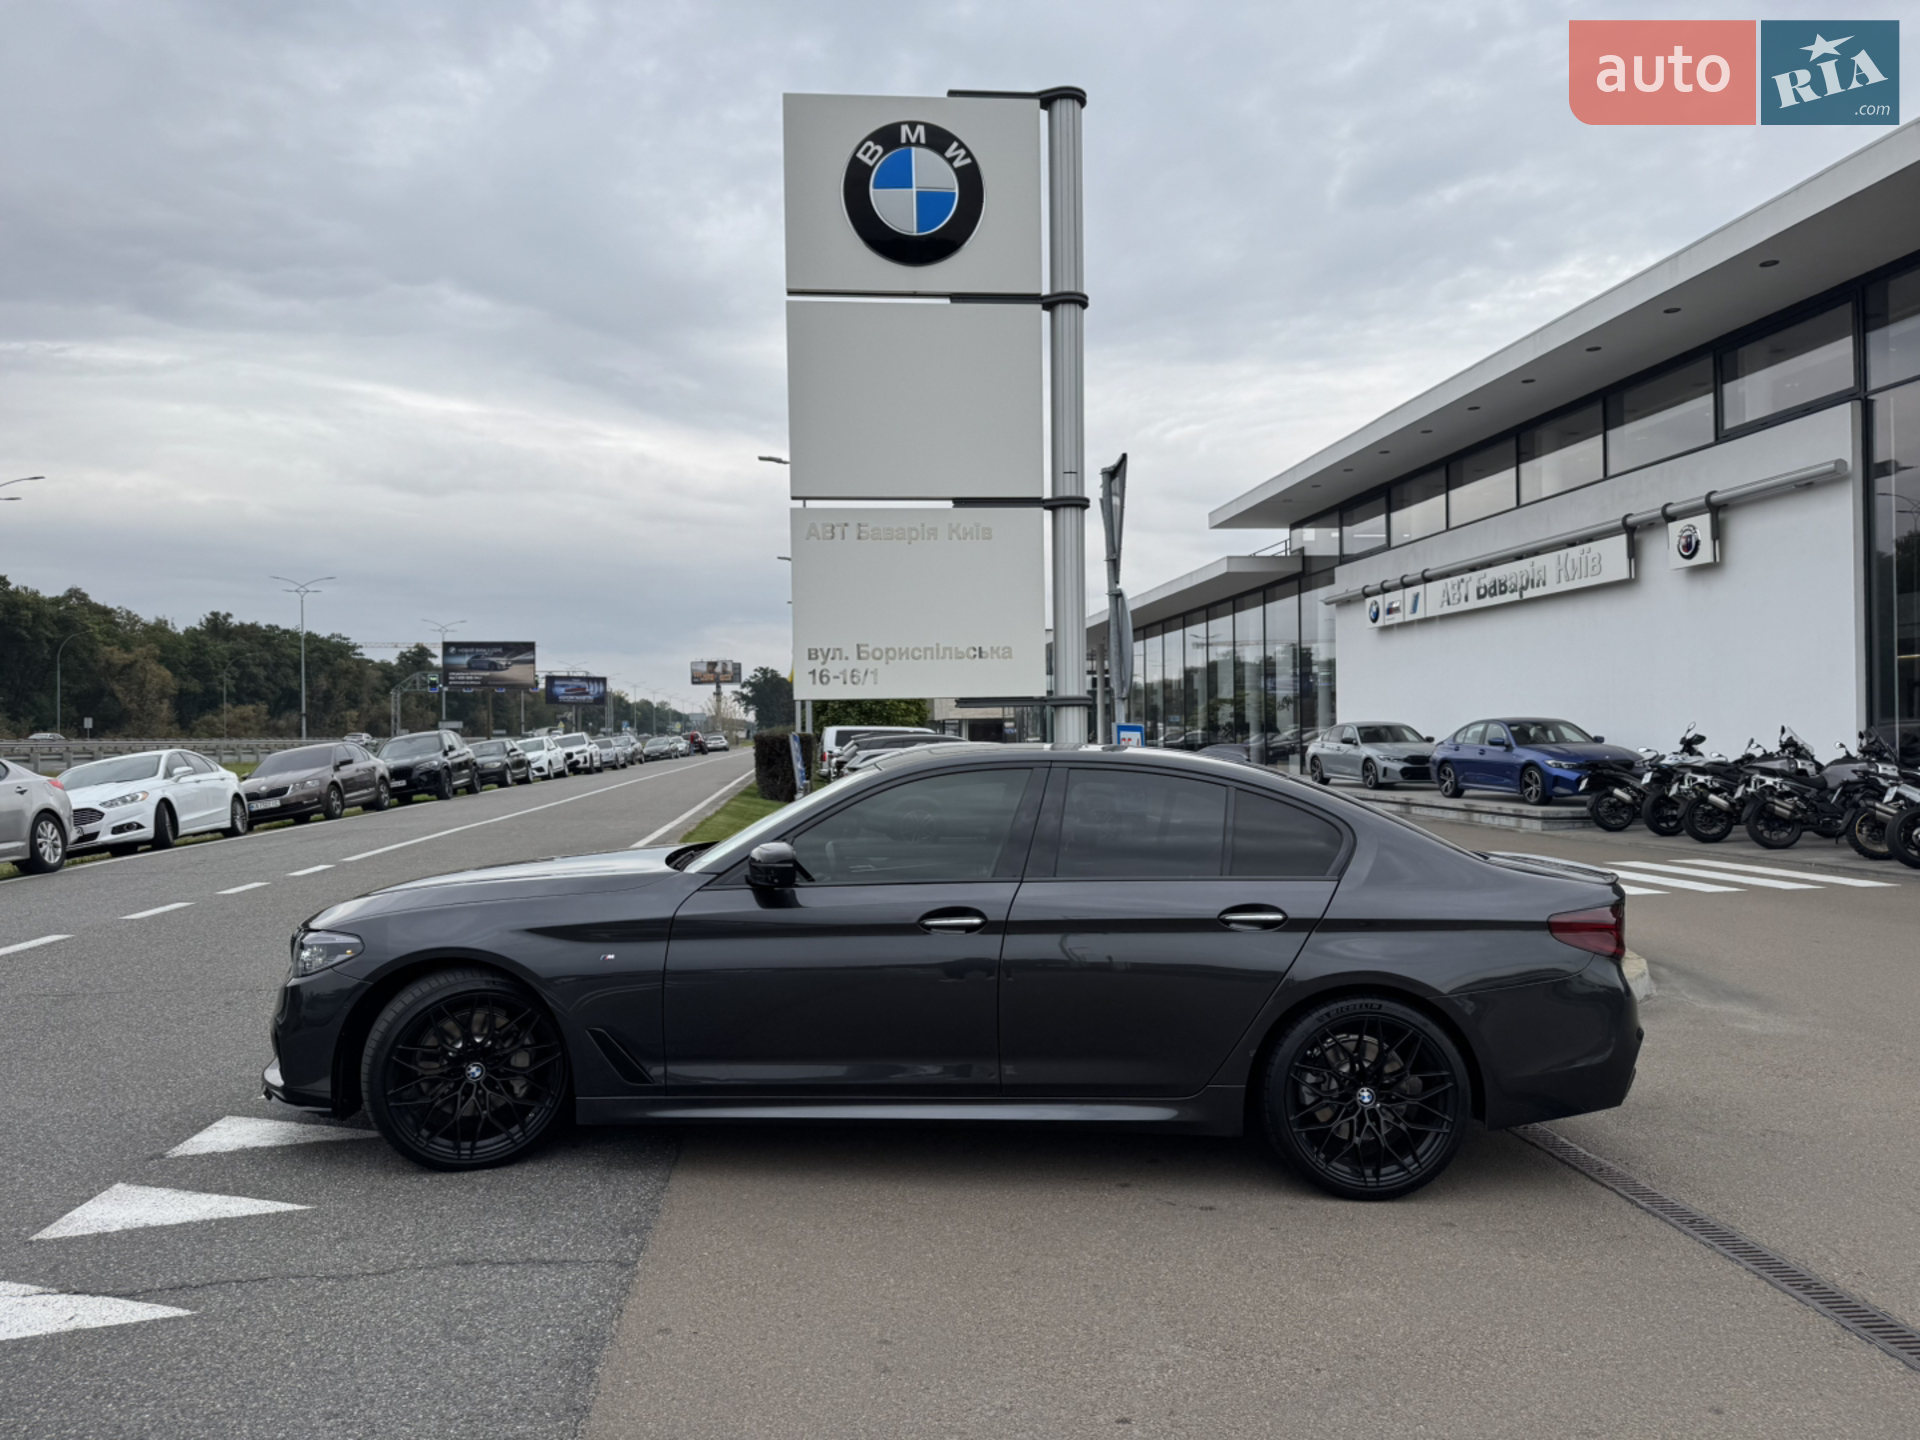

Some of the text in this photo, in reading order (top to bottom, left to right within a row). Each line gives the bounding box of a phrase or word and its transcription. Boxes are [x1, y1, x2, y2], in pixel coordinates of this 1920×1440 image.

[855, 124, 972, 169] BMW
[805, 522, 993, 545] АВТ Баварія Київ
[1476, 561, 1547, 600] Баварія
[1556, 546, 1603, 585] Київ
[807, 642, 1013, 667] вул. Бориспільська
[808, 668, 879, 686] 16-16/1
